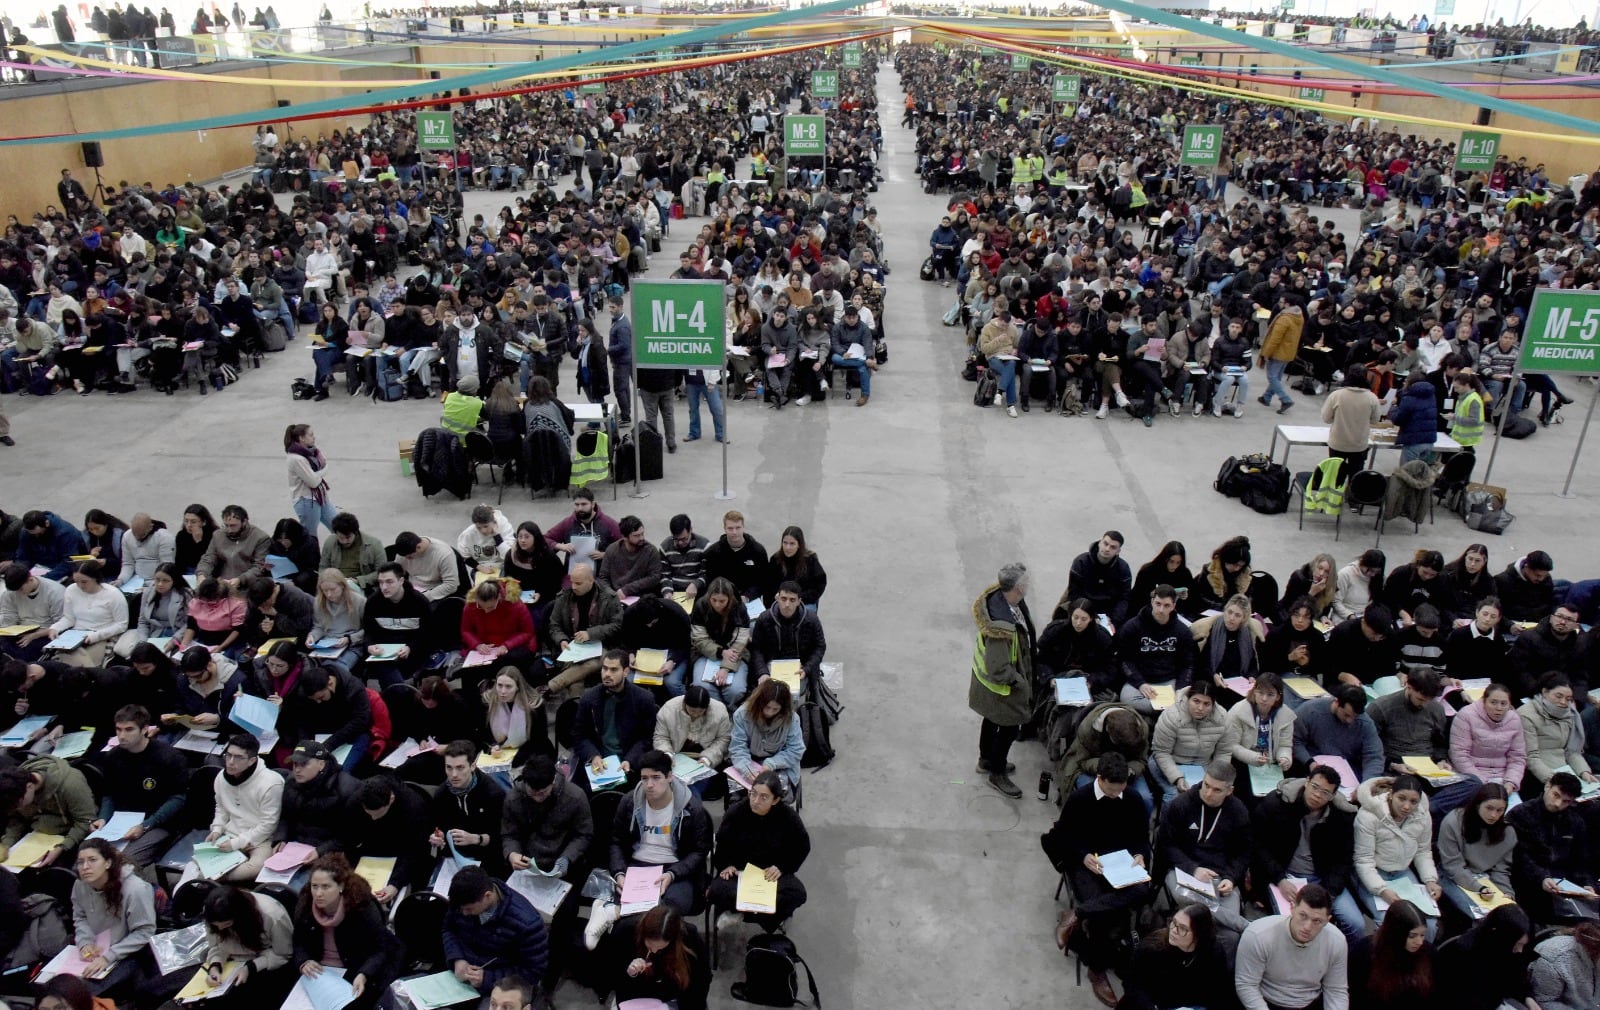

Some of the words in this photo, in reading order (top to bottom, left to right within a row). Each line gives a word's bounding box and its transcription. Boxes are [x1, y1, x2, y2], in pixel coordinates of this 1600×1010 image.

[815, 75, 836, 86] M-12
[1055, 79, 1077, 91] M-13
[424, 119, 446, 135] M-7
[792, 123, 817, 139] M-8
[1190, 132, 1215, 149] M-9
[1461, 138, 1495, 155] M-10
[651, 299, 707, 333] M-4
[1542, 306, 1600, 341] M-5
[647, 341, 712, 354] MEDICINA
[1532, 346, 1595, 360] MEDICINA
